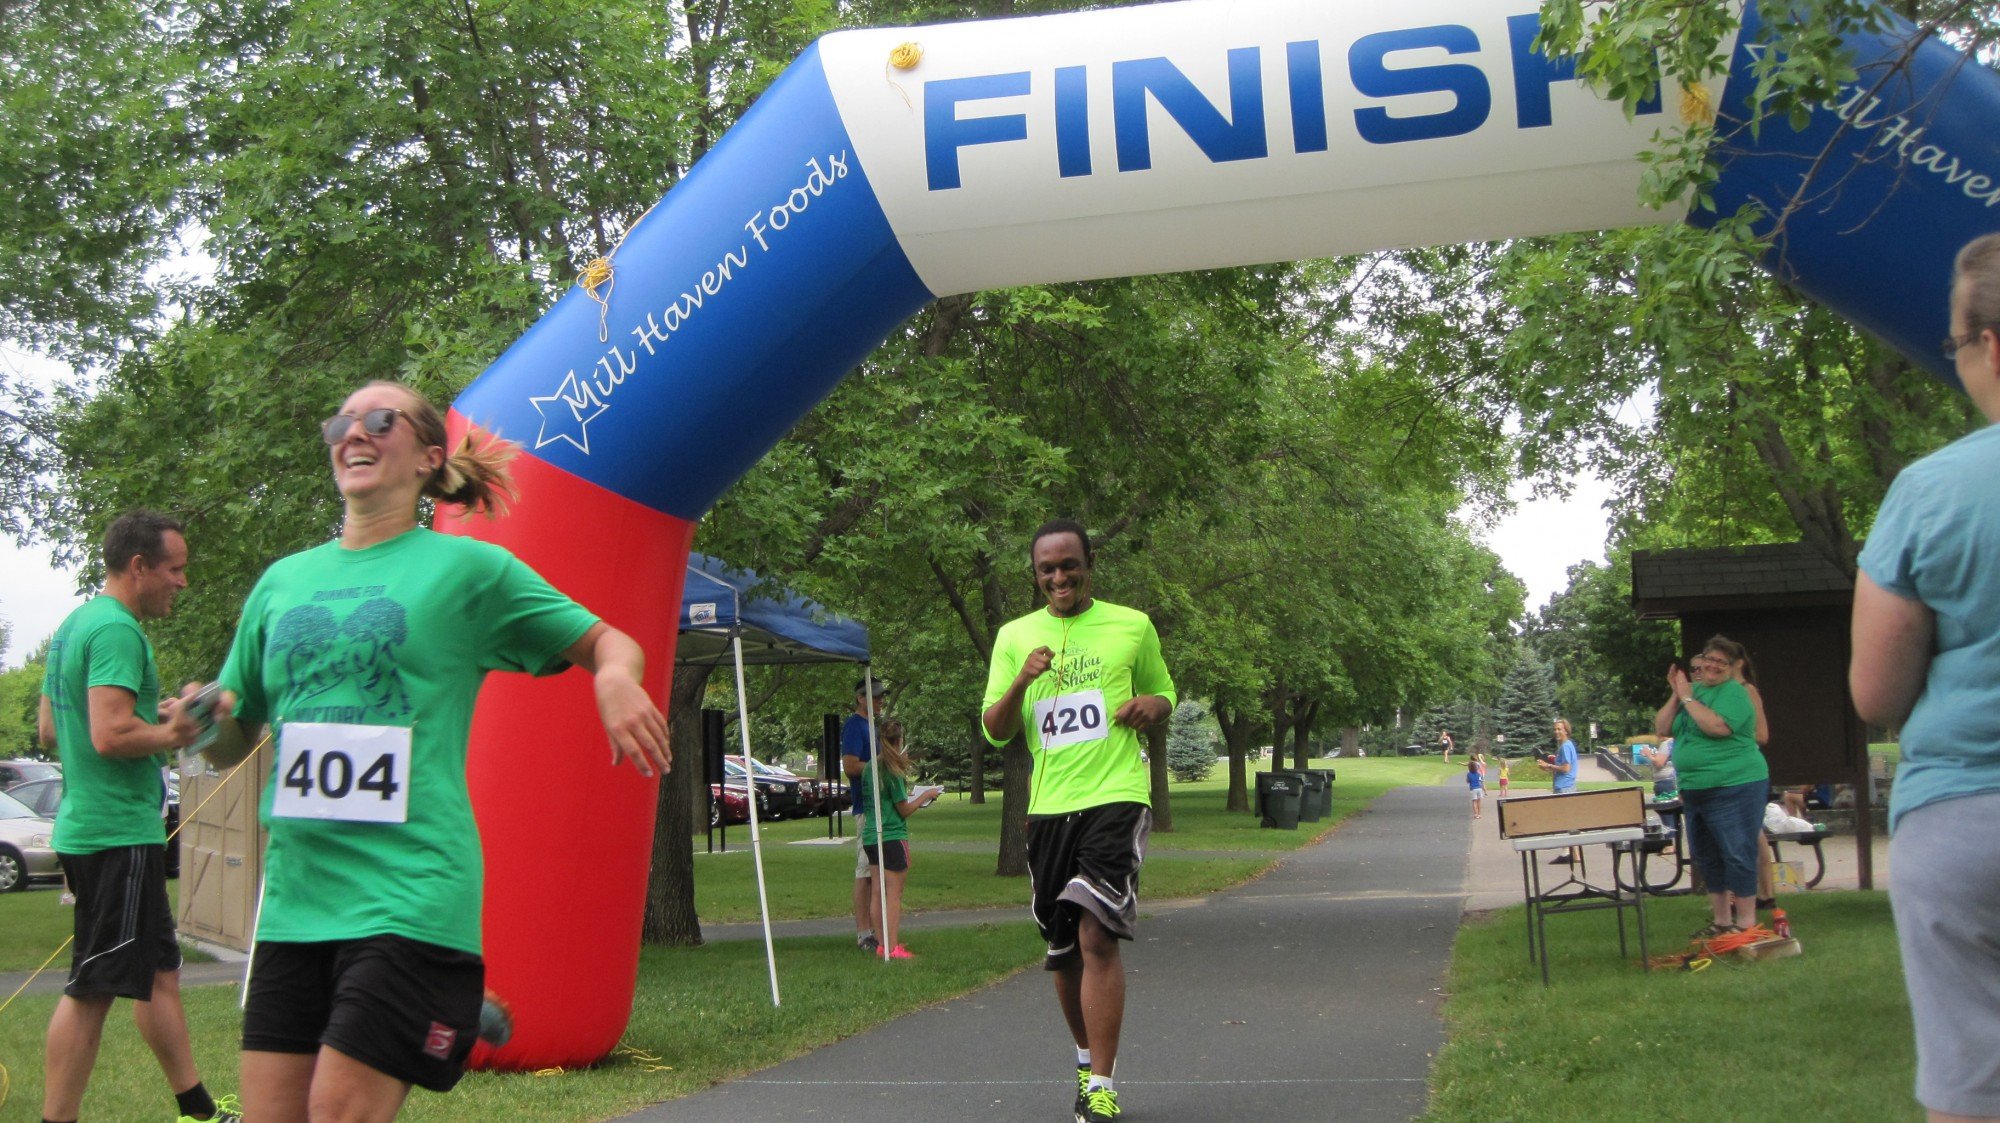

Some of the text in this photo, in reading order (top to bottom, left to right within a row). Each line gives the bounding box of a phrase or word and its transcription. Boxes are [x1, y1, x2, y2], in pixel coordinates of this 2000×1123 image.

[924, 12, 1663, 192] FINISH
[562, 149, 849, 422] Mill Haven Foods
[1060, 669, 1100, 691] Shore
[1070, 655, 1101, 674] You
[1041, 703, 1101, 737] 420
[285, 749, 399, 801] 404
